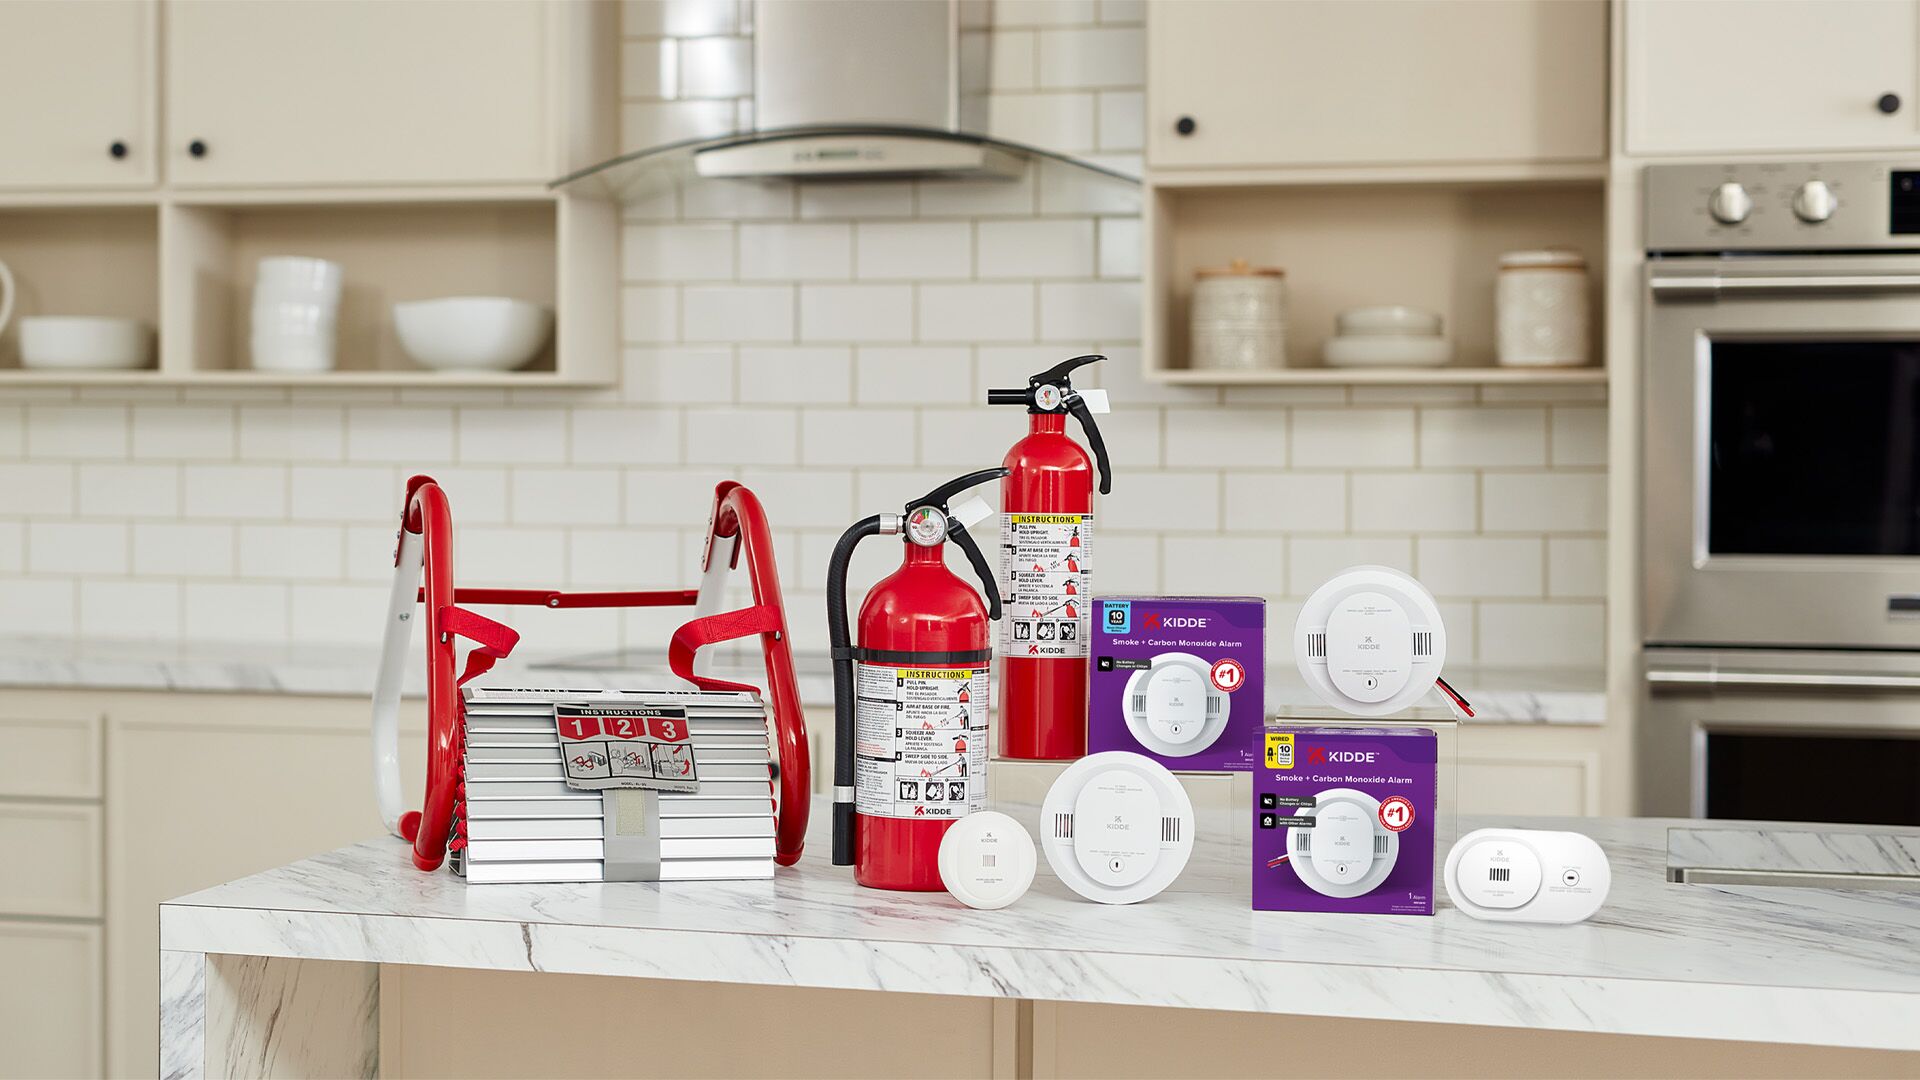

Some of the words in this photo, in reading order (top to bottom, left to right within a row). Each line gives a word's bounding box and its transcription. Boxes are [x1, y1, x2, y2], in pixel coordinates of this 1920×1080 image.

[1018, 515, 1075, 523] INSTRUCTIONS
[1111, 611, 1123, 620] 10
[1163, 618, 1207, 628] KIDDE
[1178, 640, 1216, 648] Monoxide
[906, 670, 965, 678] INSTRUCTIONS
[1218, 668, 1234, 682] #1
[570, 719, 583, 736] 1
[616, 719, 633, 736] 2
[662, 721, 677, 738] 3
[1328, 752, 1375, 762] KIDDE
[1276, 774, 1303, 782] Smoke
[1312, 774, 1342, 782] Carbon
[1344, 776, 1386, 784] Monoxide
[1388, 806, 1403, 822] #1
